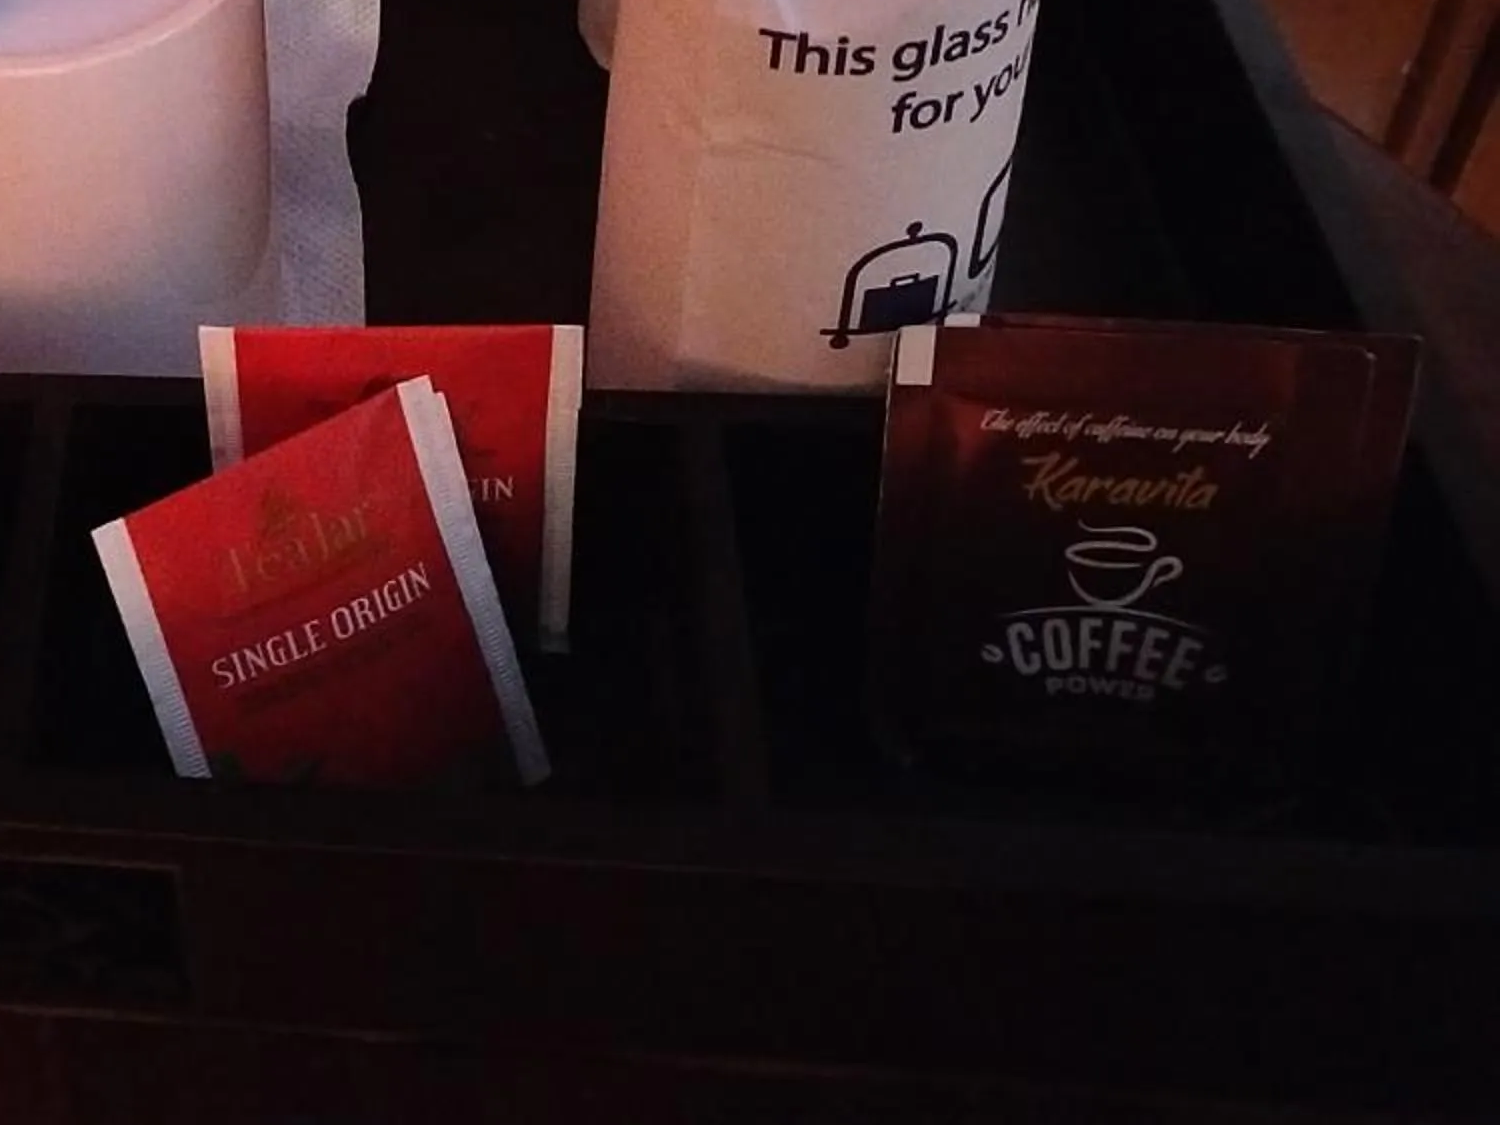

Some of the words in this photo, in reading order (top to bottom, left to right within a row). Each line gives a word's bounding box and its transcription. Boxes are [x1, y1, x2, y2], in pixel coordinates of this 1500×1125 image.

[758, 27, 876, 75] This
[893, 10, 1009, 81] glass
[892, 91, 964, 133] for
[1015, 410, 1067, 439] effect
[1153, 426, 1178, 441] on
[1171, 428, 1225, 454] your
[1224, 421, 1270, 460] body
[1020, 452, 1219, 511] Karavita
[211, 619, 327, 689] SINGLE
[330, 561, 432, 641] ORIGIN
[1006, 618, 1204, 690] COFFEE
